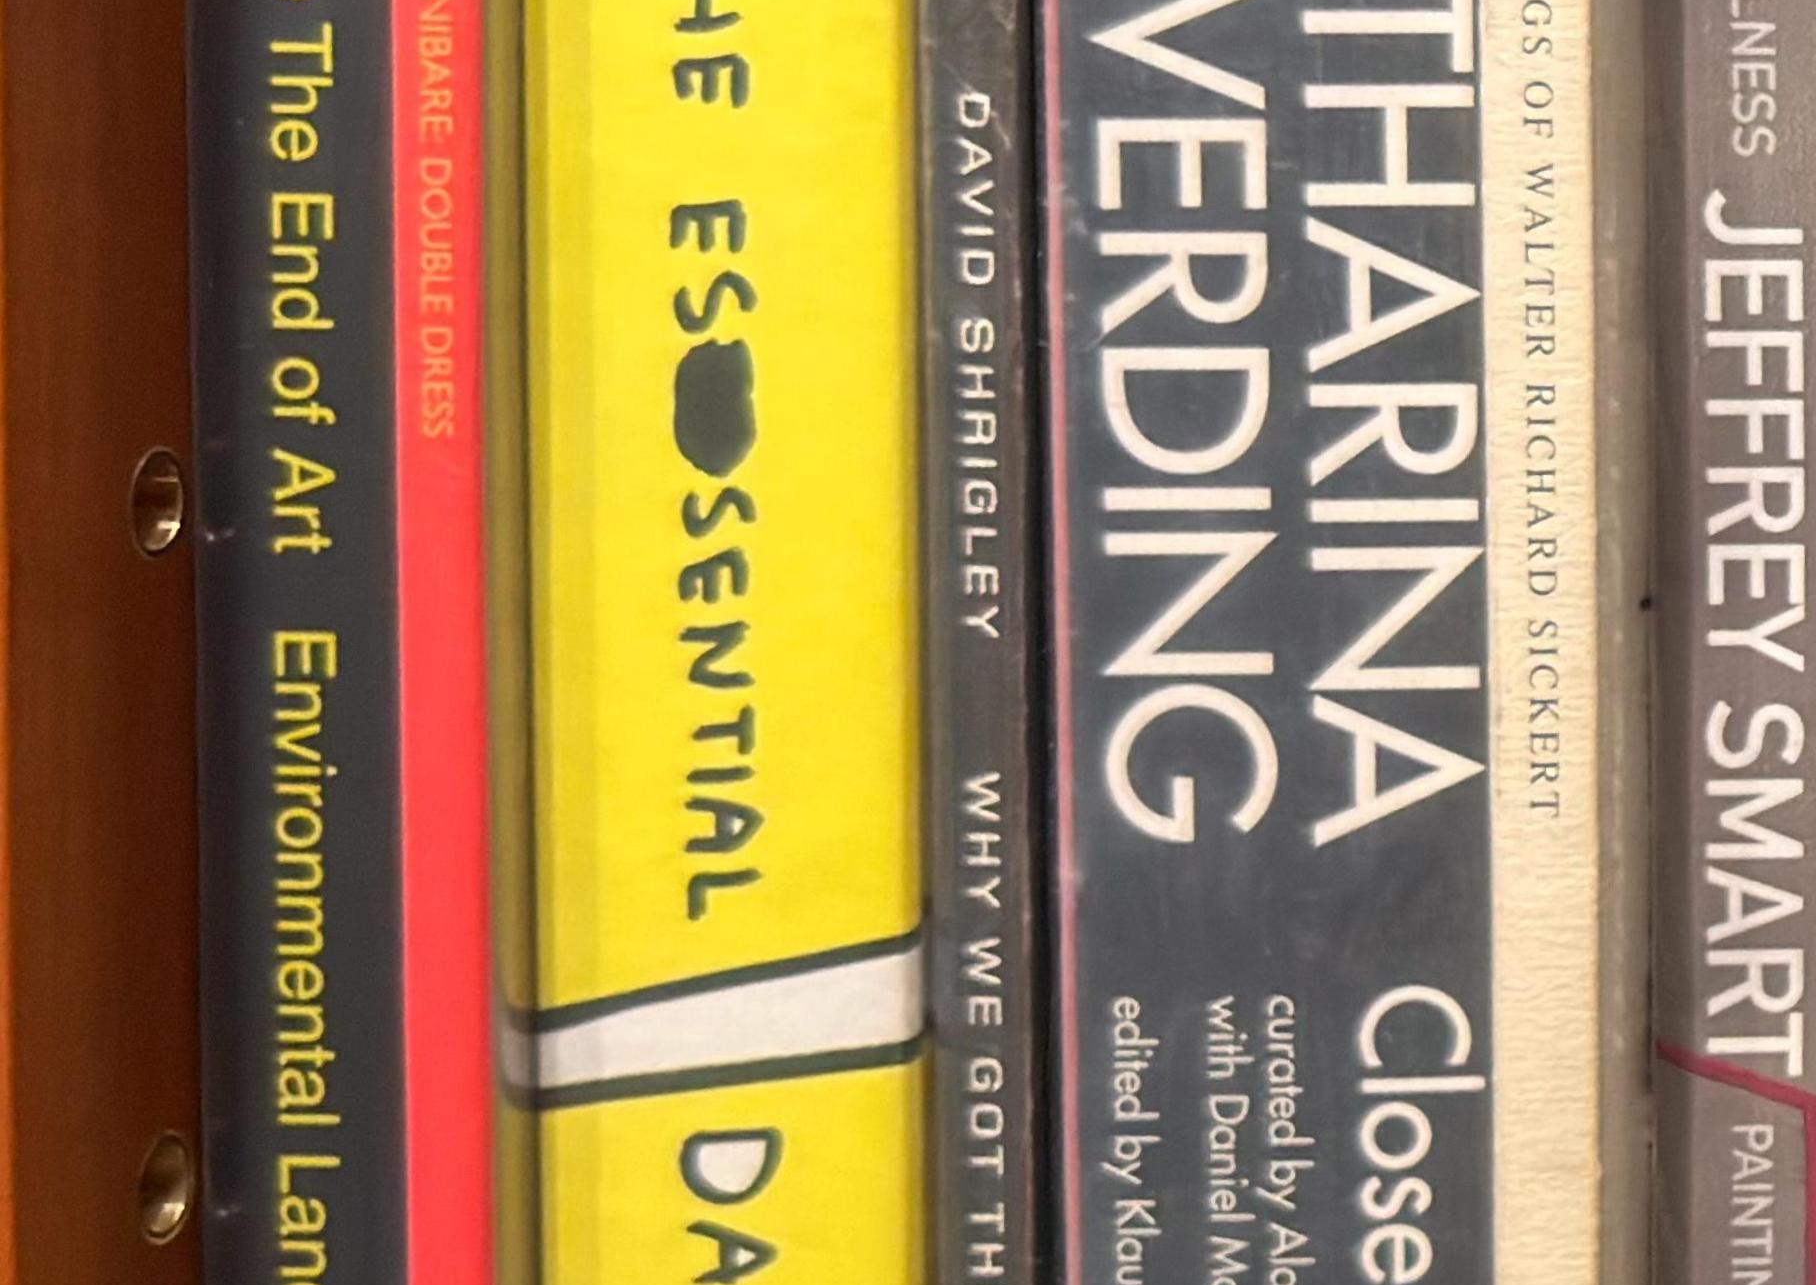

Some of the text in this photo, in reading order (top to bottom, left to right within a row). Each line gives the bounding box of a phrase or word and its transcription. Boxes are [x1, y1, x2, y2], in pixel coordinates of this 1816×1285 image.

[270, 21, 334, 161] The
[1521, 80, 1554, 137] OF
[420, 155, 456, 313] DOUBLE
[957, 90, 998, 285] DAVID
[272, 192, 335, 330] End
[1522, 162, 1556, 358] WALTER
[270, 355, 335, 423] of
[421, 325, 457, 437] DRESS
[272, 448, 337, 553] Art
[958, 315, 1000, 637] SHRIGLEY
[1524, 382, 1557, 595] RICHARD
[1703, 188, 1805, 1077] JEFFREY SMART
[1526, 618, 1559, 818] SICKERT
[273, 630, 342, 1125] Environmental
[960, 770, 1000, 910] WHY
[965, 937, 1002, 1028] WE
[968, 1057, 1004, 1175] GOT
[1208, 1093, 1252, 1220] Daniel
[1355, 985, 1490, 1283] Close
